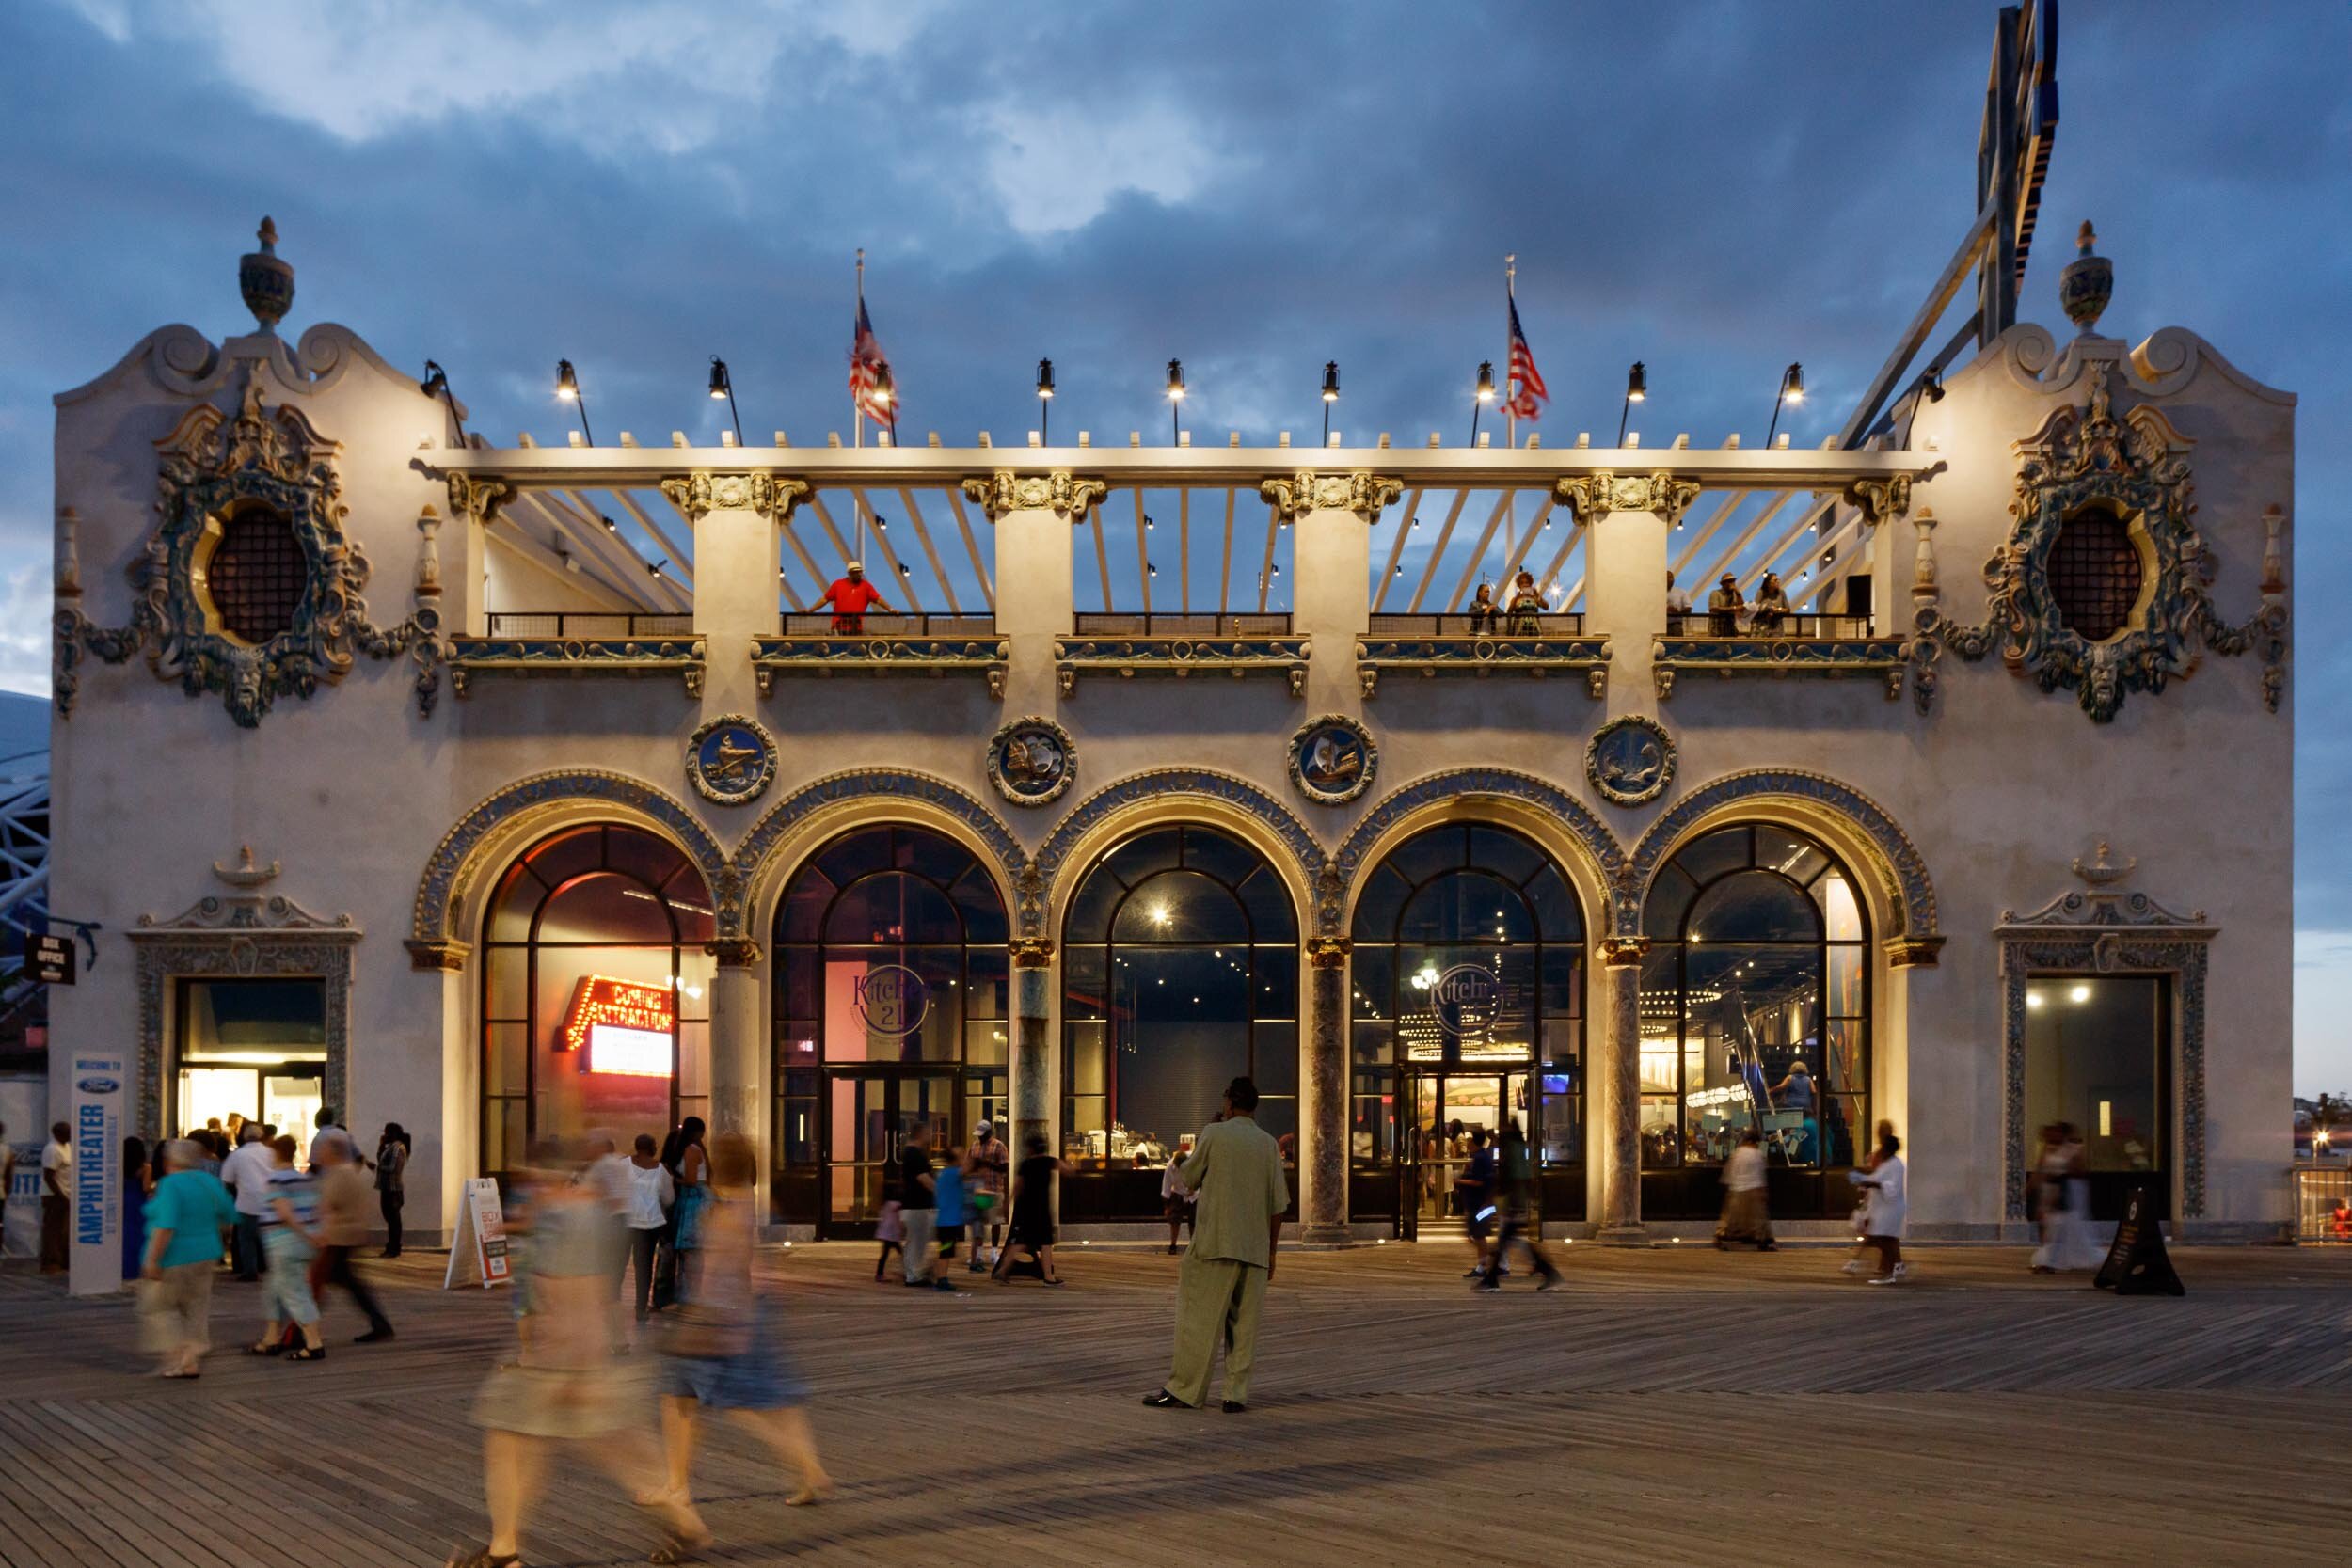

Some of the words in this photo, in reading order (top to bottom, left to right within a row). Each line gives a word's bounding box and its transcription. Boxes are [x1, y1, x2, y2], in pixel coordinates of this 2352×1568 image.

[37, 950, 65, 965] OFFICE
[613, 985, 661, 1010] COMING
[852, 974, 932, 1006] Kitche
[596, 1003, 672, 1031] ATTRACTION
[881, 1002, 904, 1025] 21
[112, 1061, 121, 1071] TO
[78, 1104, 103, 1245] AMPHITHEATER
